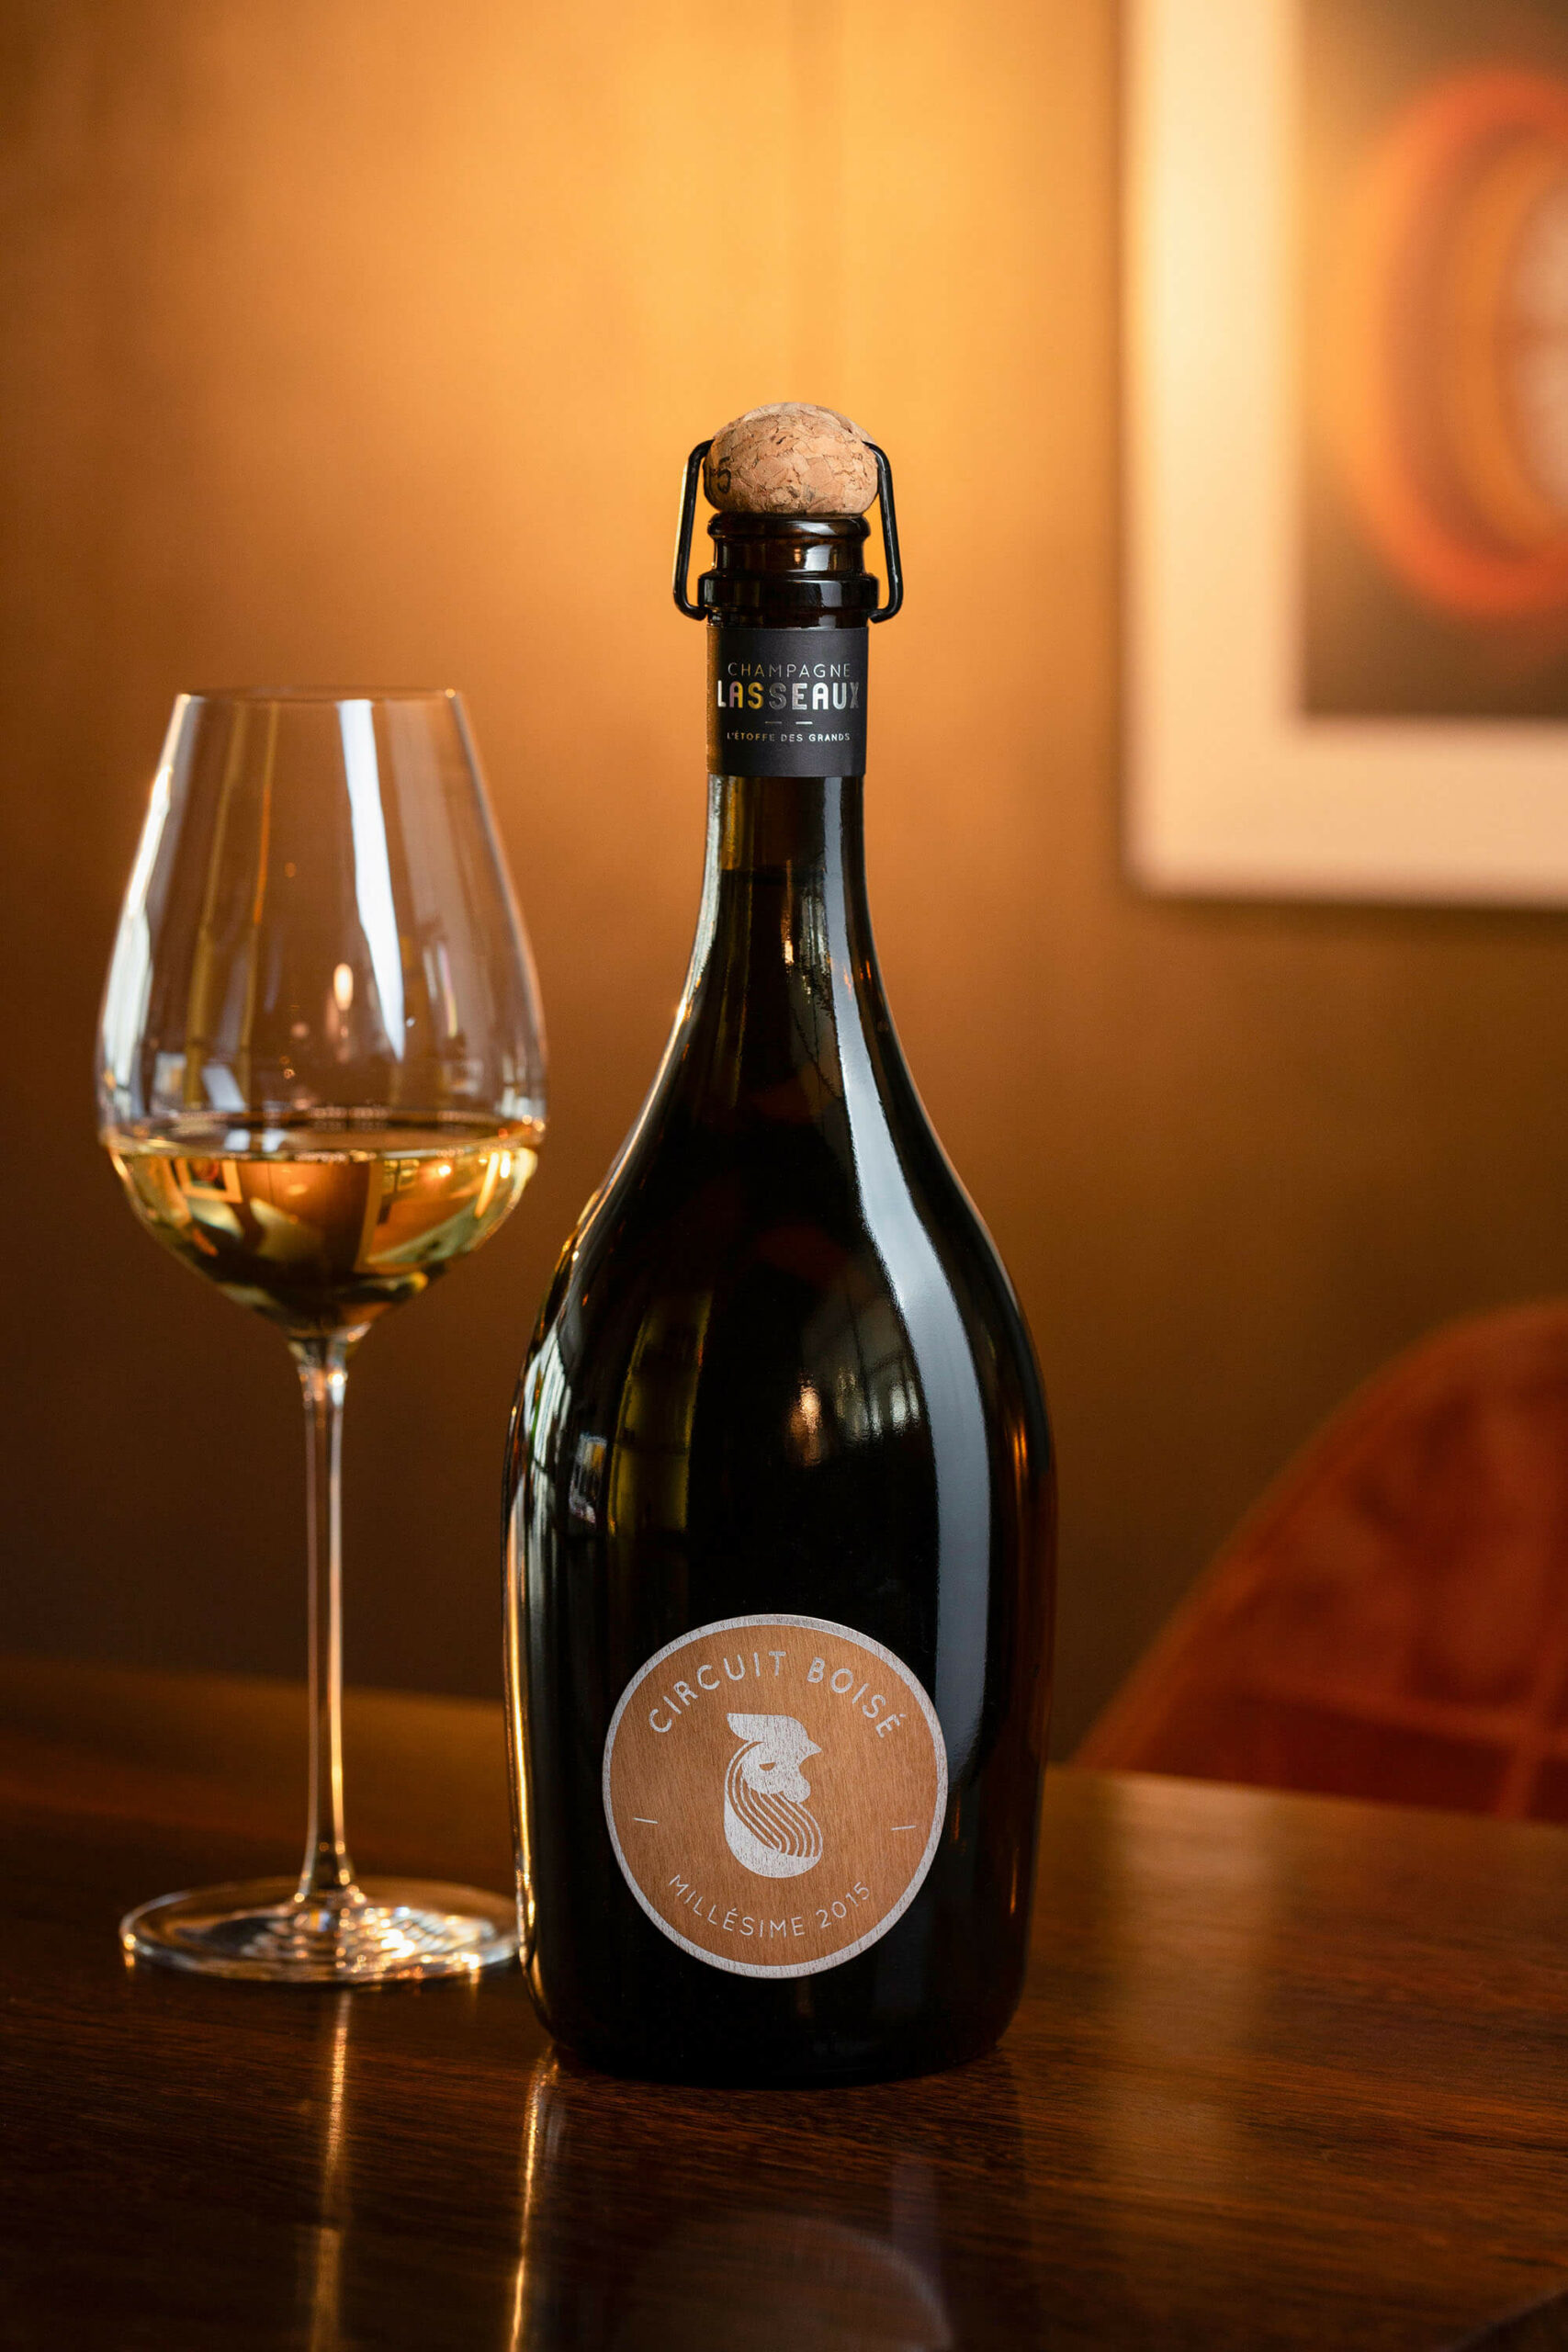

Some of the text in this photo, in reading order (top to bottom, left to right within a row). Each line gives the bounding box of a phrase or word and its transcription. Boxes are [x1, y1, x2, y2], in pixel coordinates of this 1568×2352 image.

[728, 662, 851, 678] CHAMPAGNE
[717, 680, 860, 710] LASSEAUX
[781, 733, 804, 742] DES
[808, 732, 851, 742] GRANDS
[649, 1651, 907, 1738] CIRCUIT BOISÉ
[669, 1874, 870, 1938] MILLÉSIME 2015
